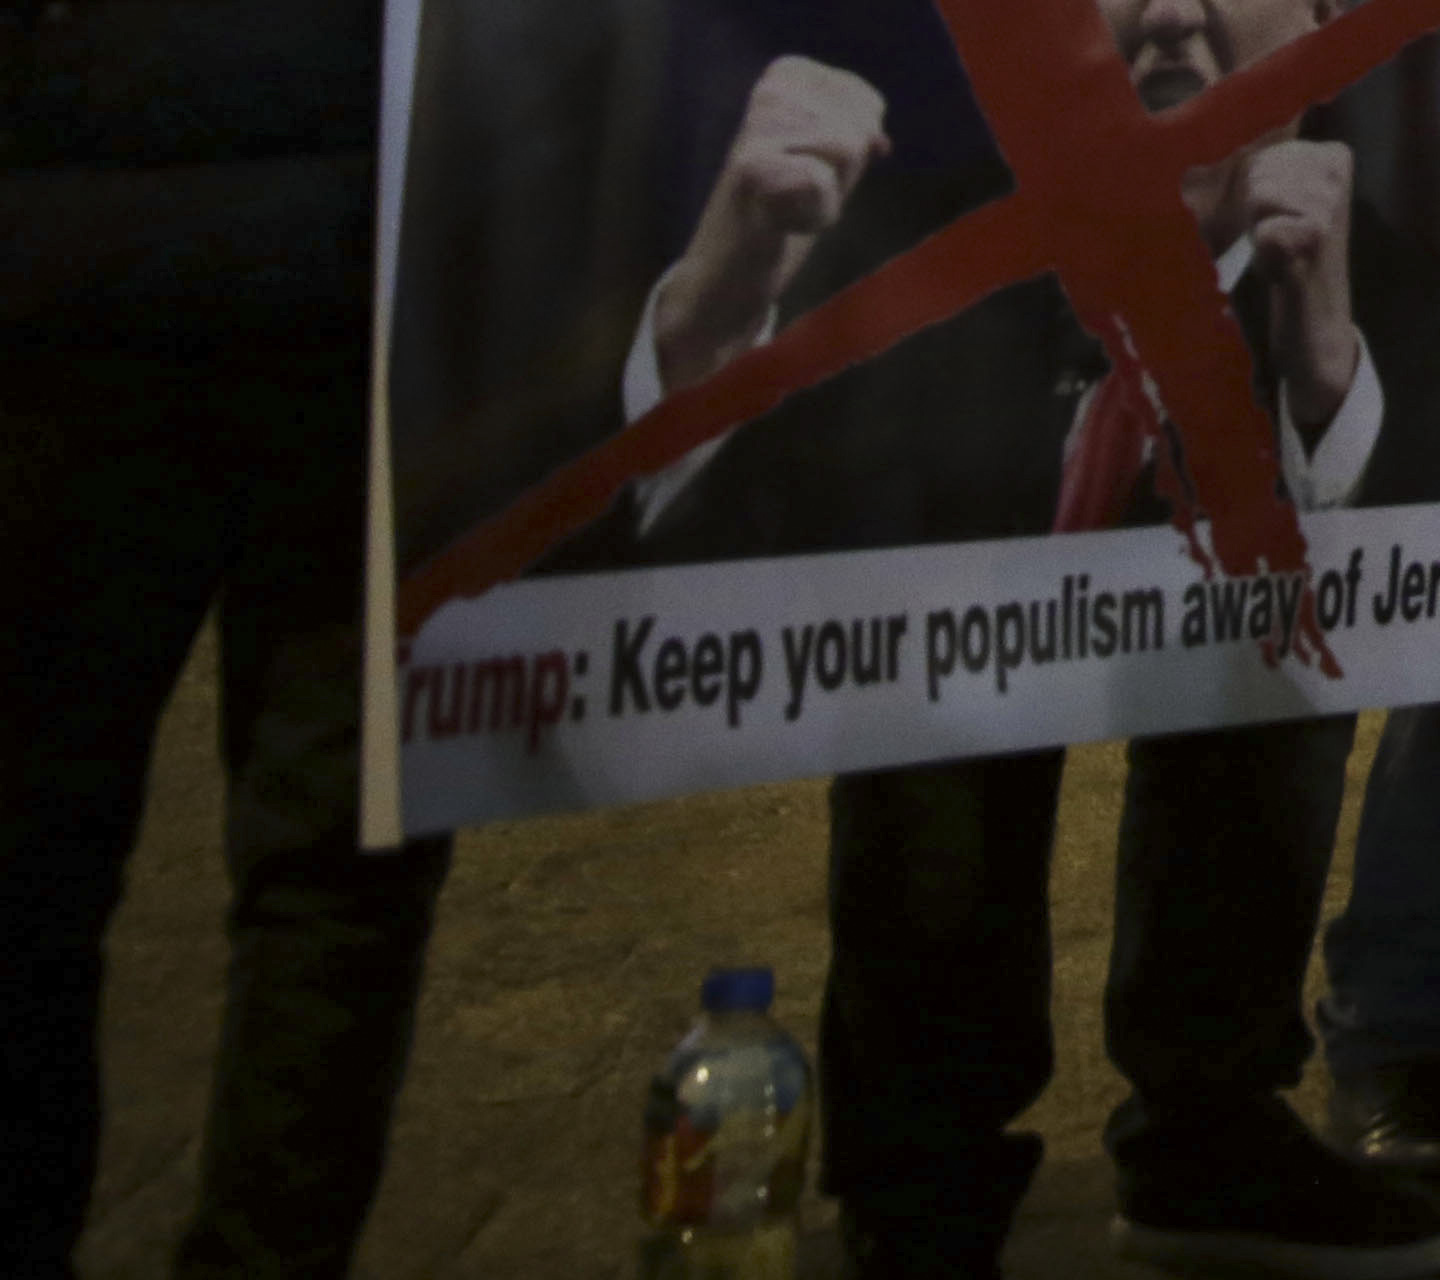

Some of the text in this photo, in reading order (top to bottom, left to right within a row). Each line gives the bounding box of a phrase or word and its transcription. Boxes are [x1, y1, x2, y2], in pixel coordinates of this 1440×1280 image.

[399, 645, 588, 756] rump:
[608, 614, 762, 728] Keep
[783, 615, 906, 722] your
[926, 572, 1164, 702] populism
[1182, 572, 1303, 658] away
[1316, 547, 1364, 631] of
